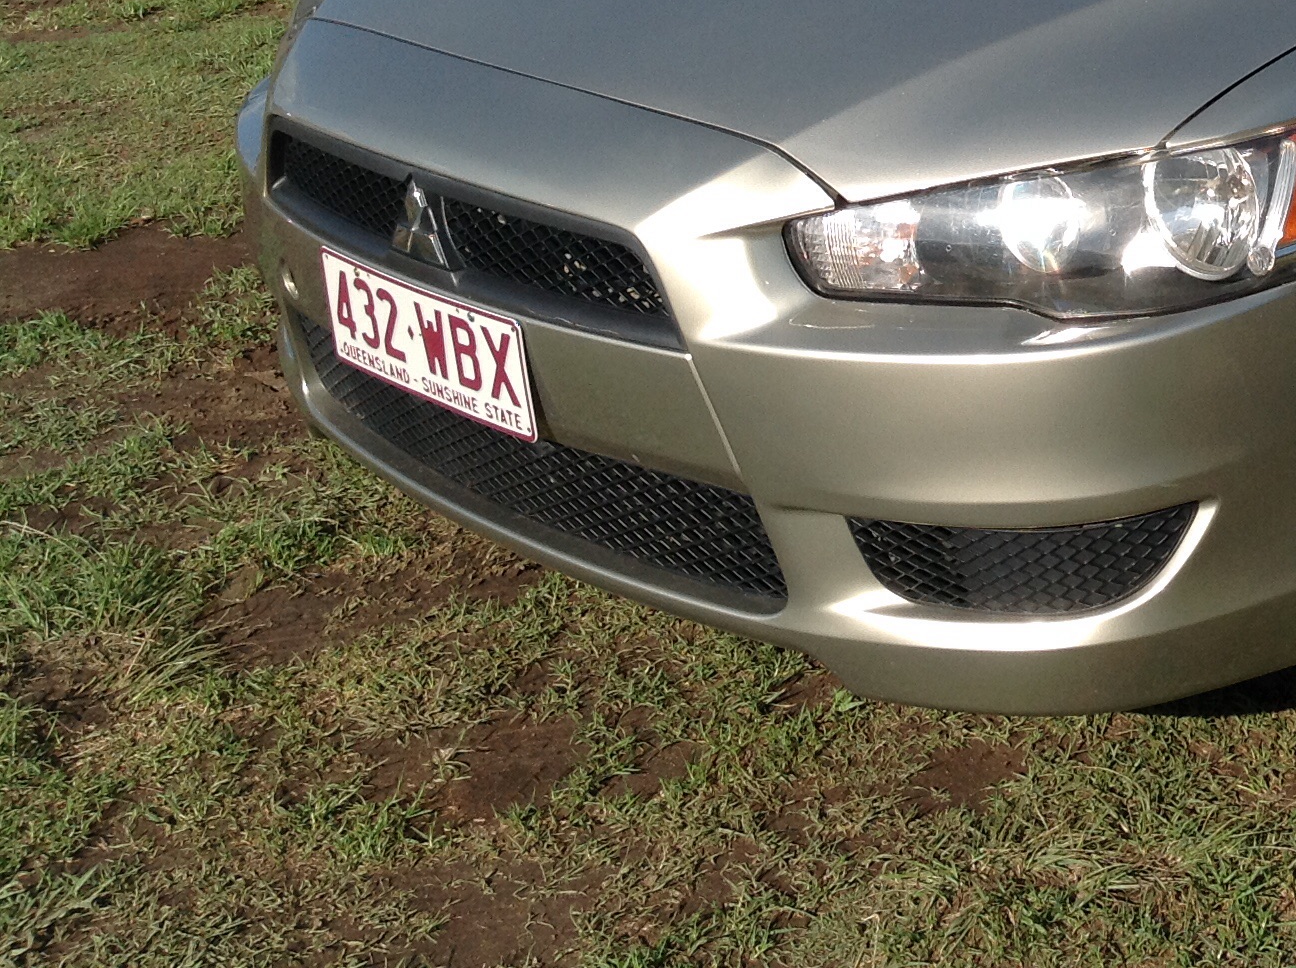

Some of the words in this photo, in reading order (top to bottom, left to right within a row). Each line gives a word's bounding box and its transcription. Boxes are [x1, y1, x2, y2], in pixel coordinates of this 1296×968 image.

[336, 269, 407, 363] 432
[413, 301, 522, 408] WBX
[342, 341, 410, 384] QUEENSLAND
[422, 377, 480, 414] SUNSHINE
[484, 402, 523, 431] STATE
